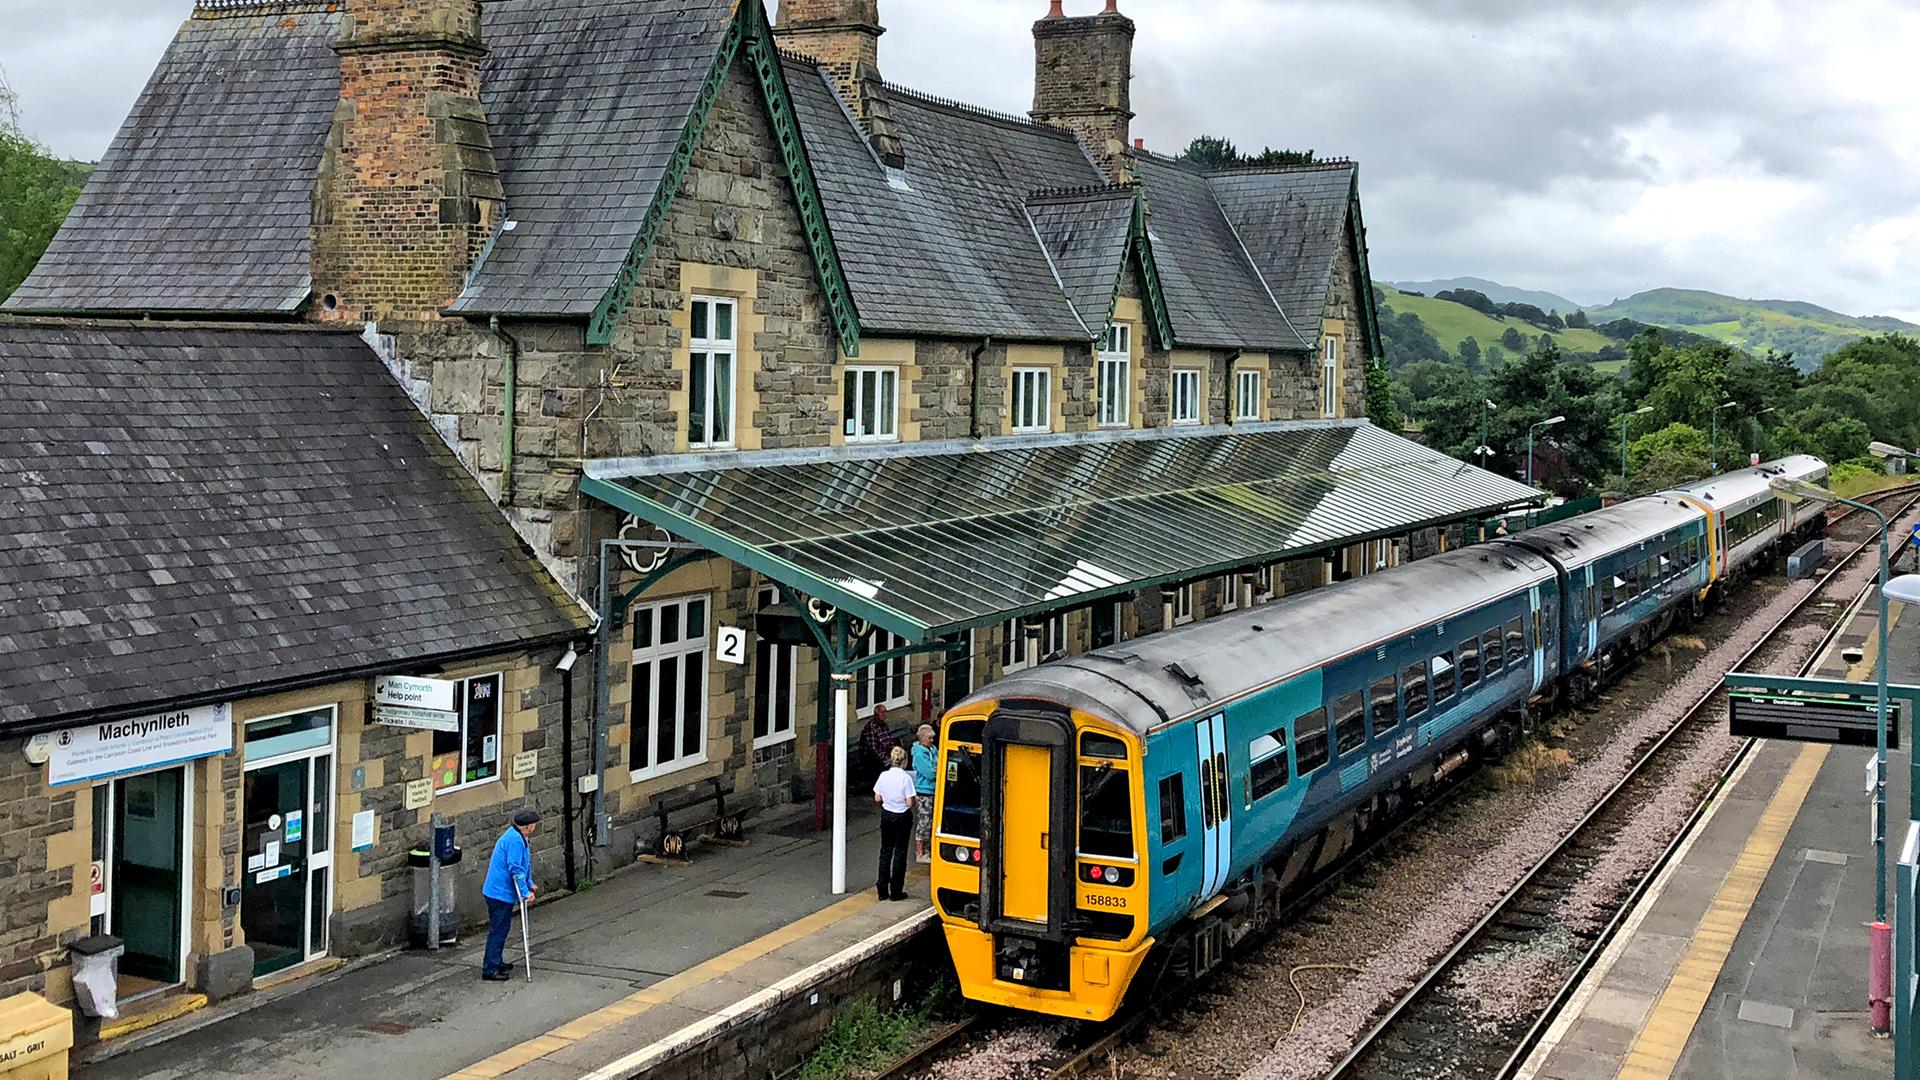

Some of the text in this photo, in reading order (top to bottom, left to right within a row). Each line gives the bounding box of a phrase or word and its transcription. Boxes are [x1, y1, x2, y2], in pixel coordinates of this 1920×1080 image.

[724, 633, 738, 657] 2
[387, 680, 433, 692] Man Cymorth
[387, 690, 422, 702] Help point
[99, 712, 190, 741] Machynlleth
[721, 817, 738, 835] GWR
[663, 833, 683, 855] GWR
[1085, 894, 1127, 908] 158833
[0, 1050, 17, 1063] SALT
[26, 1040, 45, 1055] GRIT
